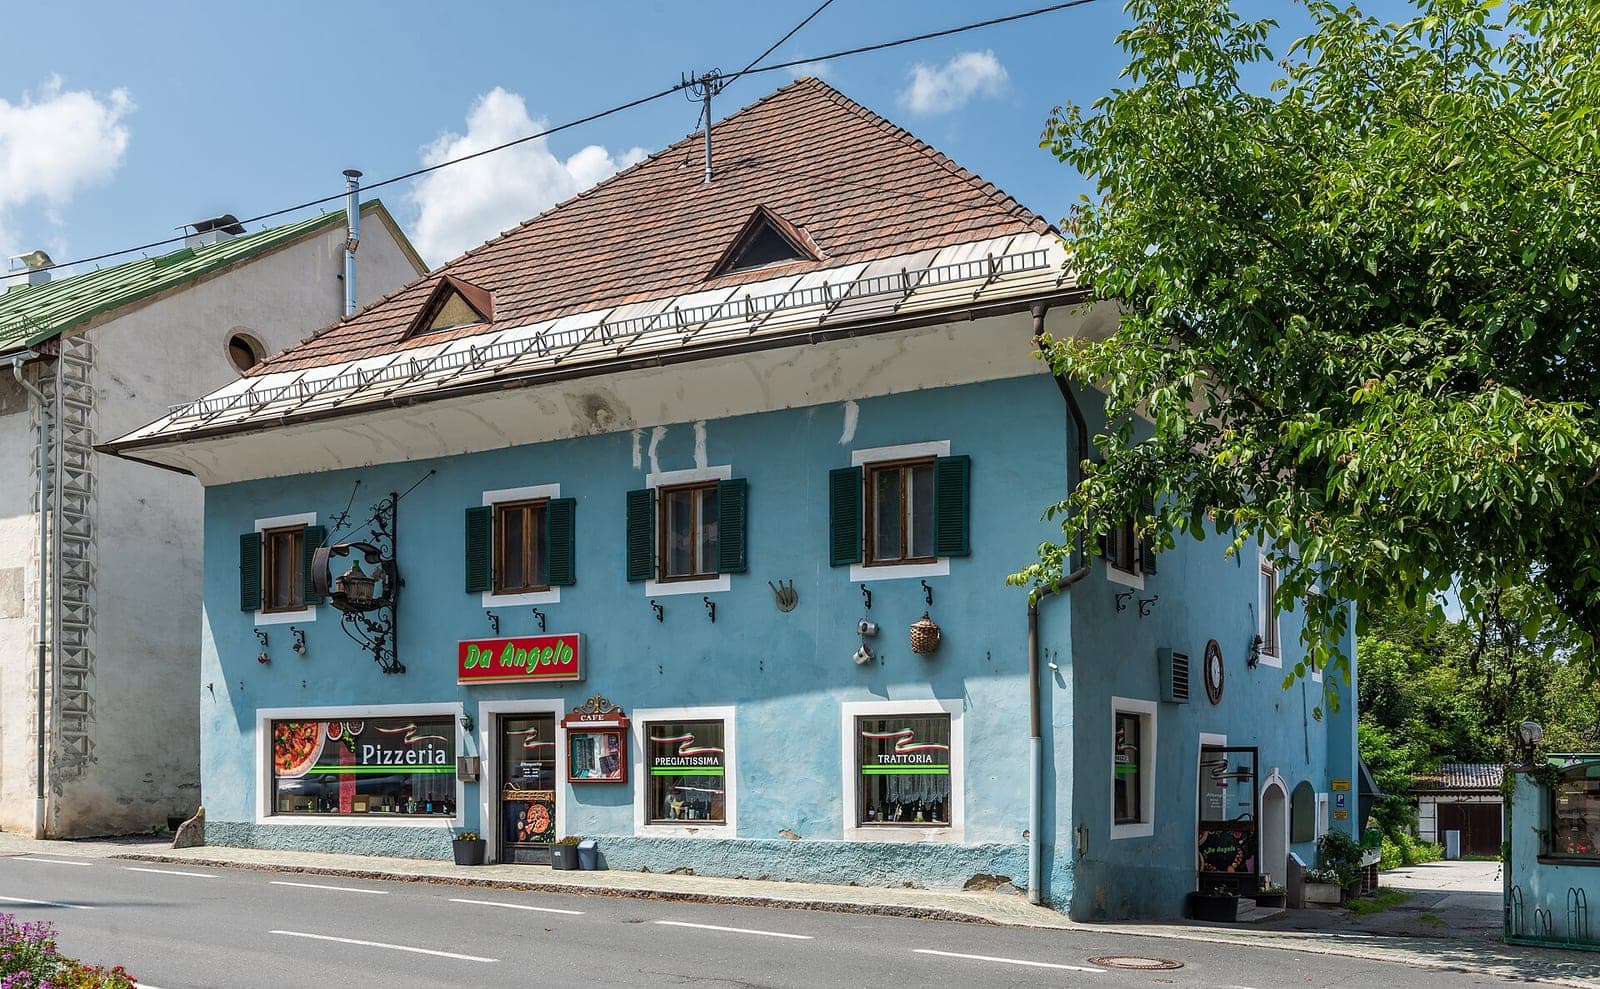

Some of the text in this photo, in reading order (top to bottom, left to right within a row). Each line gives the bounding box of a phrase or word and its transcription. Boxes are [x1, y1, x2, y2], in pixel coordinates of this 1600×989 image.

[464, 639, 573, 674] Da Angelo
[362, 743, 446, 765] Pizzeria
[655, 757, 719, 766] PREGIATISSIMA
[877, 754, 933, 764] TRATTORIA
